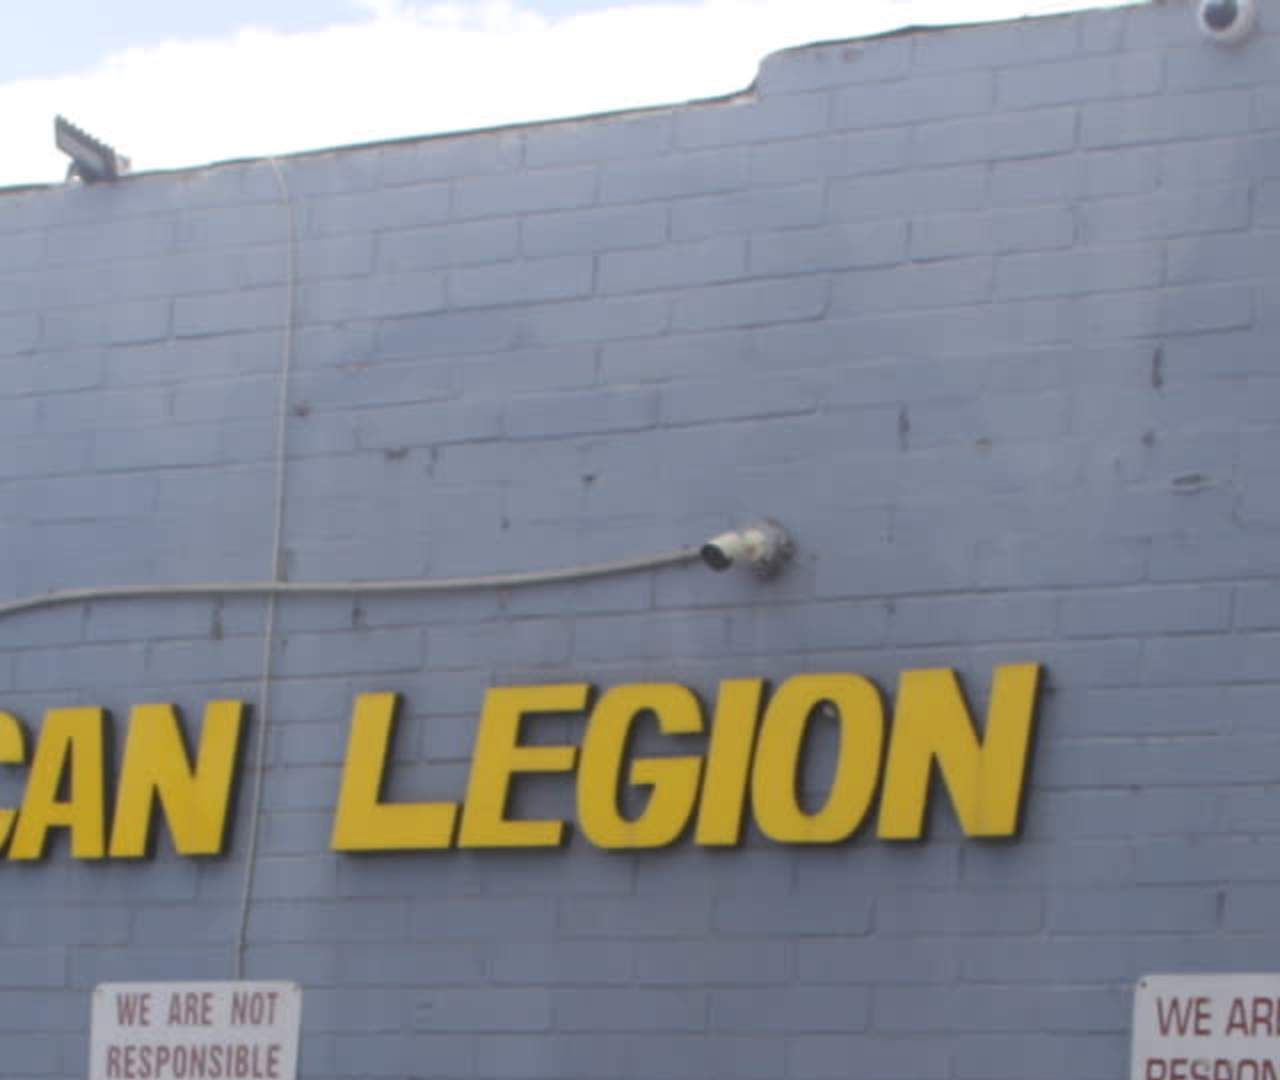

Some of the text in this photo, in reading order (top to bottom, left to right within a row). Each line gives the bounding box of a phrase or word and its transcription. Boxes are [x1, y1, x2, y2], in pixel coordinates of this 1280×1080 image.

[330, 662, 1041, 852] LEGION
[116, 992, 280, 1026] WE ARE NOT
[1156, 997, 1212, 1037] WE
[106, 1045, 282, 1079] RESPONSIBLE
